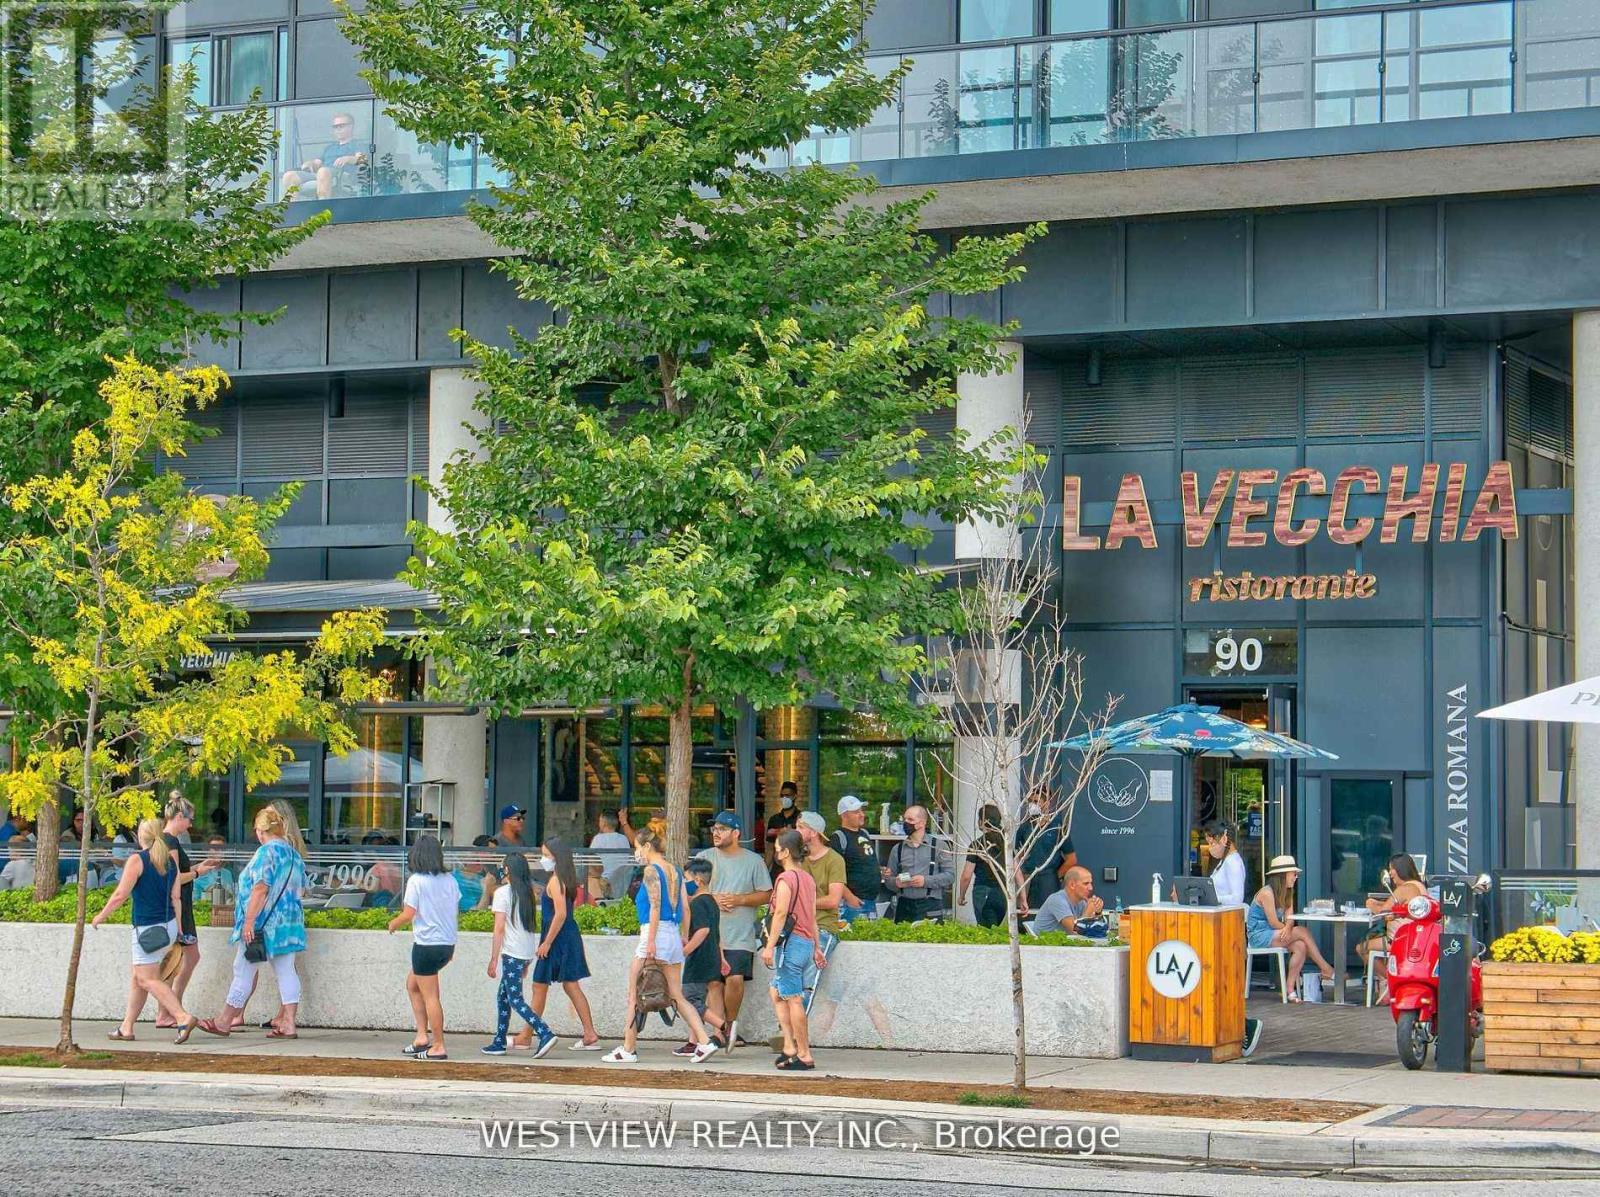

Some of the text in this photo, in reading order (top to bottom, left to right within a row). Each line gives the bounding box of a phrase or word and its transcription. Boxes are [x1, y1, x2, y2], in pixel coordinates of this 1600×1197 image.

[1062, 460, 1520, 550] LA VECCHIA
[1188, 567, 1378, 602] ristorante
[1215, 637, 1263, 671] 90
[1447, 683, 1468, 812] ROMANA
[1101, 826, 1135, 835] since 1996
[1447, 816, 1469, 876] ZZA
[1155, 951, 1195, 988] LAV
